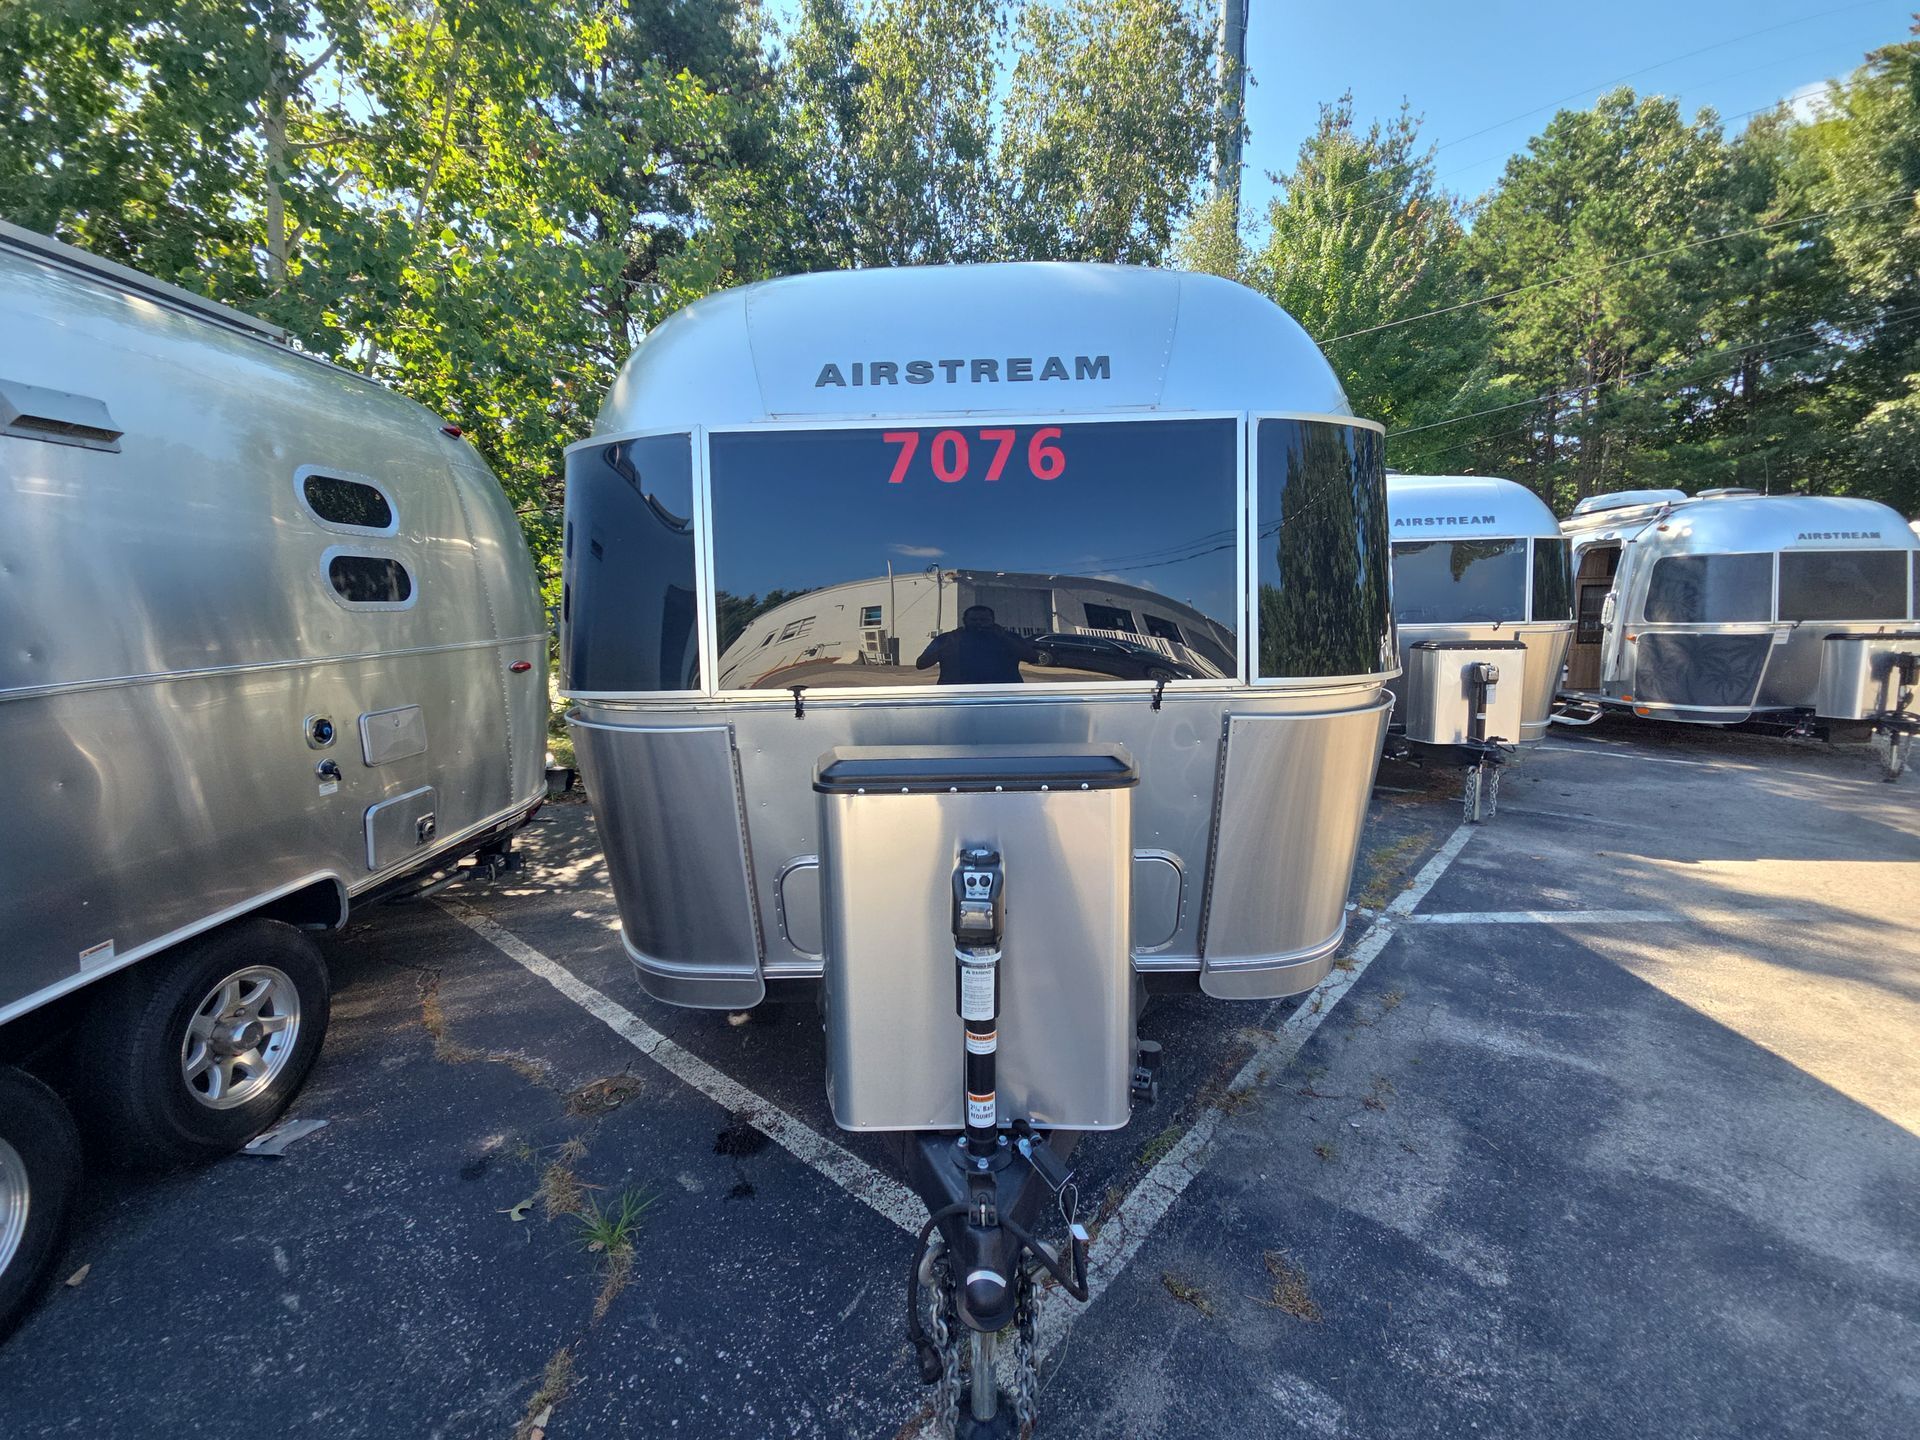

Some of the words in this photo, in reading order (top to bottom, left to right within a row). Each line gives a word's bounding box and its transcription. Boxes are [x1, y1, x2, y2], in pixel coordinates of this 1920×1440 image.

[815, 355, 1111, 387] AIRSTREAM
[883, 427, 1067, 484] 7076
[1394, 515, 1496, 527] AIRSTREAM
[1797, 531, 1881, 541] AIRSTREAM
